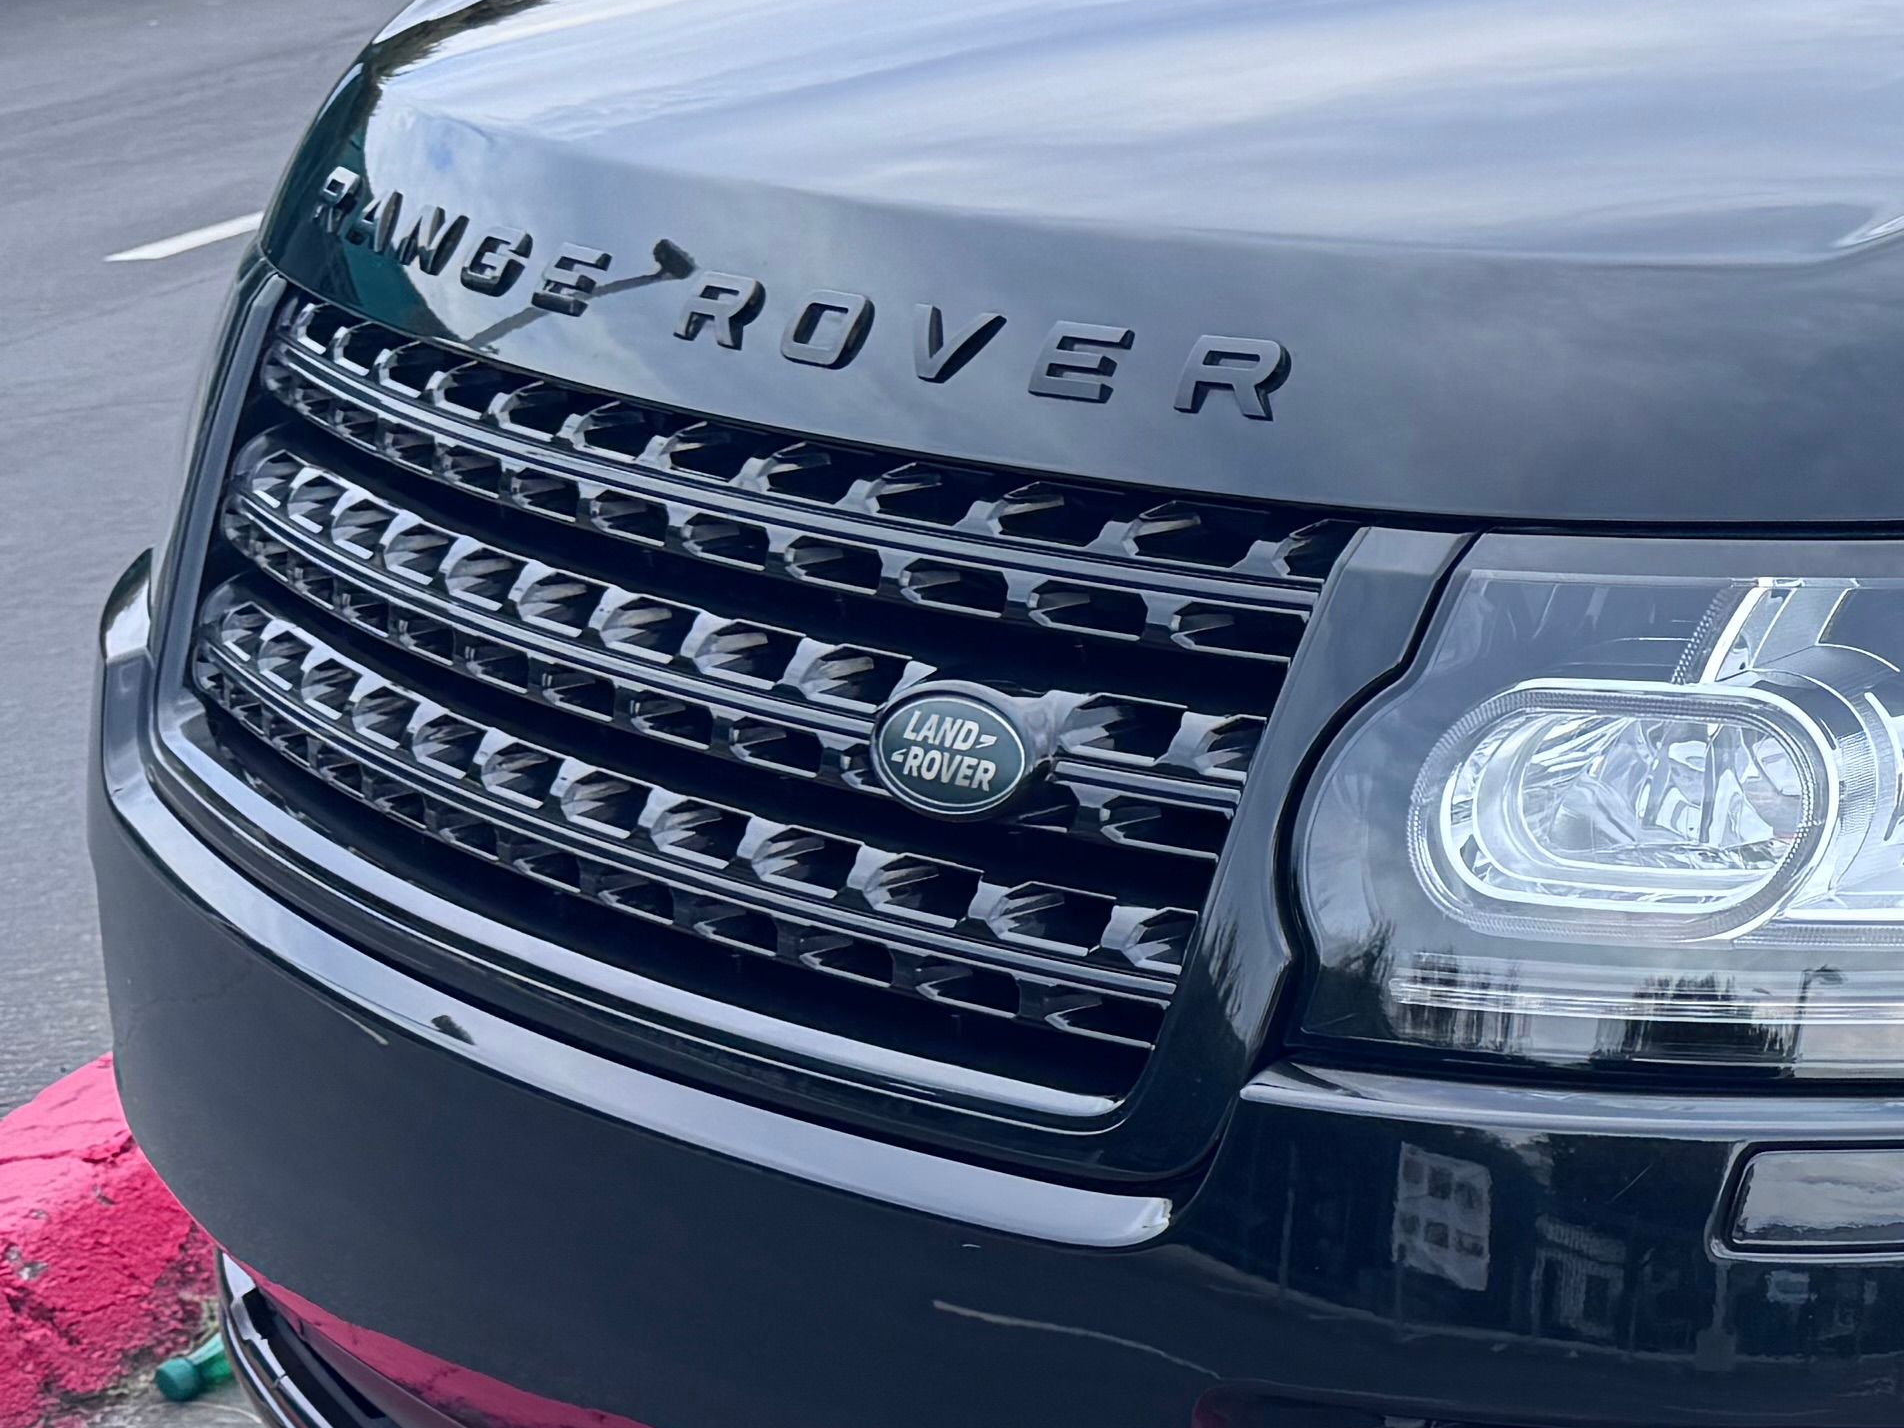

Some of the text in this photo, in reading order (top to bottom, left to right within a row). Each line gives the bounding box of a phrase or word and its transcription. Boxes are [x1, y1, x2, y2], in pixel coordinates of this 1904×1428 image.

[315, 165, 1293, 423] RANGE ROVER
[903, 710, 980, 752] LAND
[902, 745, 997, 792] ROVER
